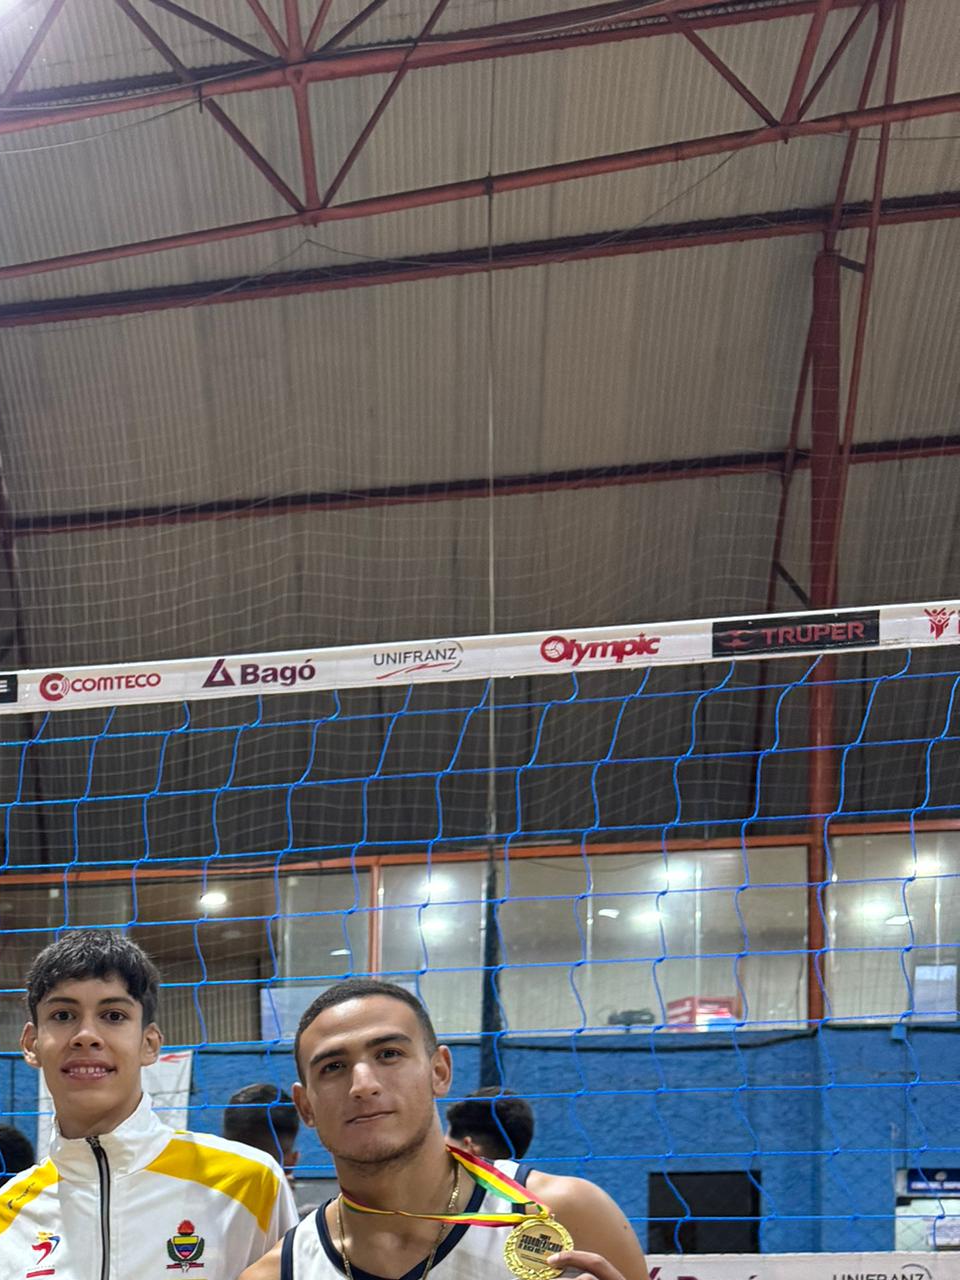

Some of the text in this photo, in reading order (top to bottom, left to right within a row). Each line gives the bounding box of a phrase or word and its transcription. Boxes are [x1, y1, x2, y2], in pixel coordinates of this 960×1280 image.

[761, 621, 866, 644] TRUPER
[373, 646, 457, 667] UNIFRANZ
[540, 630, 661, 667] Olympic
[70, 673, 162, 693] COMTECO
[240, 658, 317, 687] Bagó
